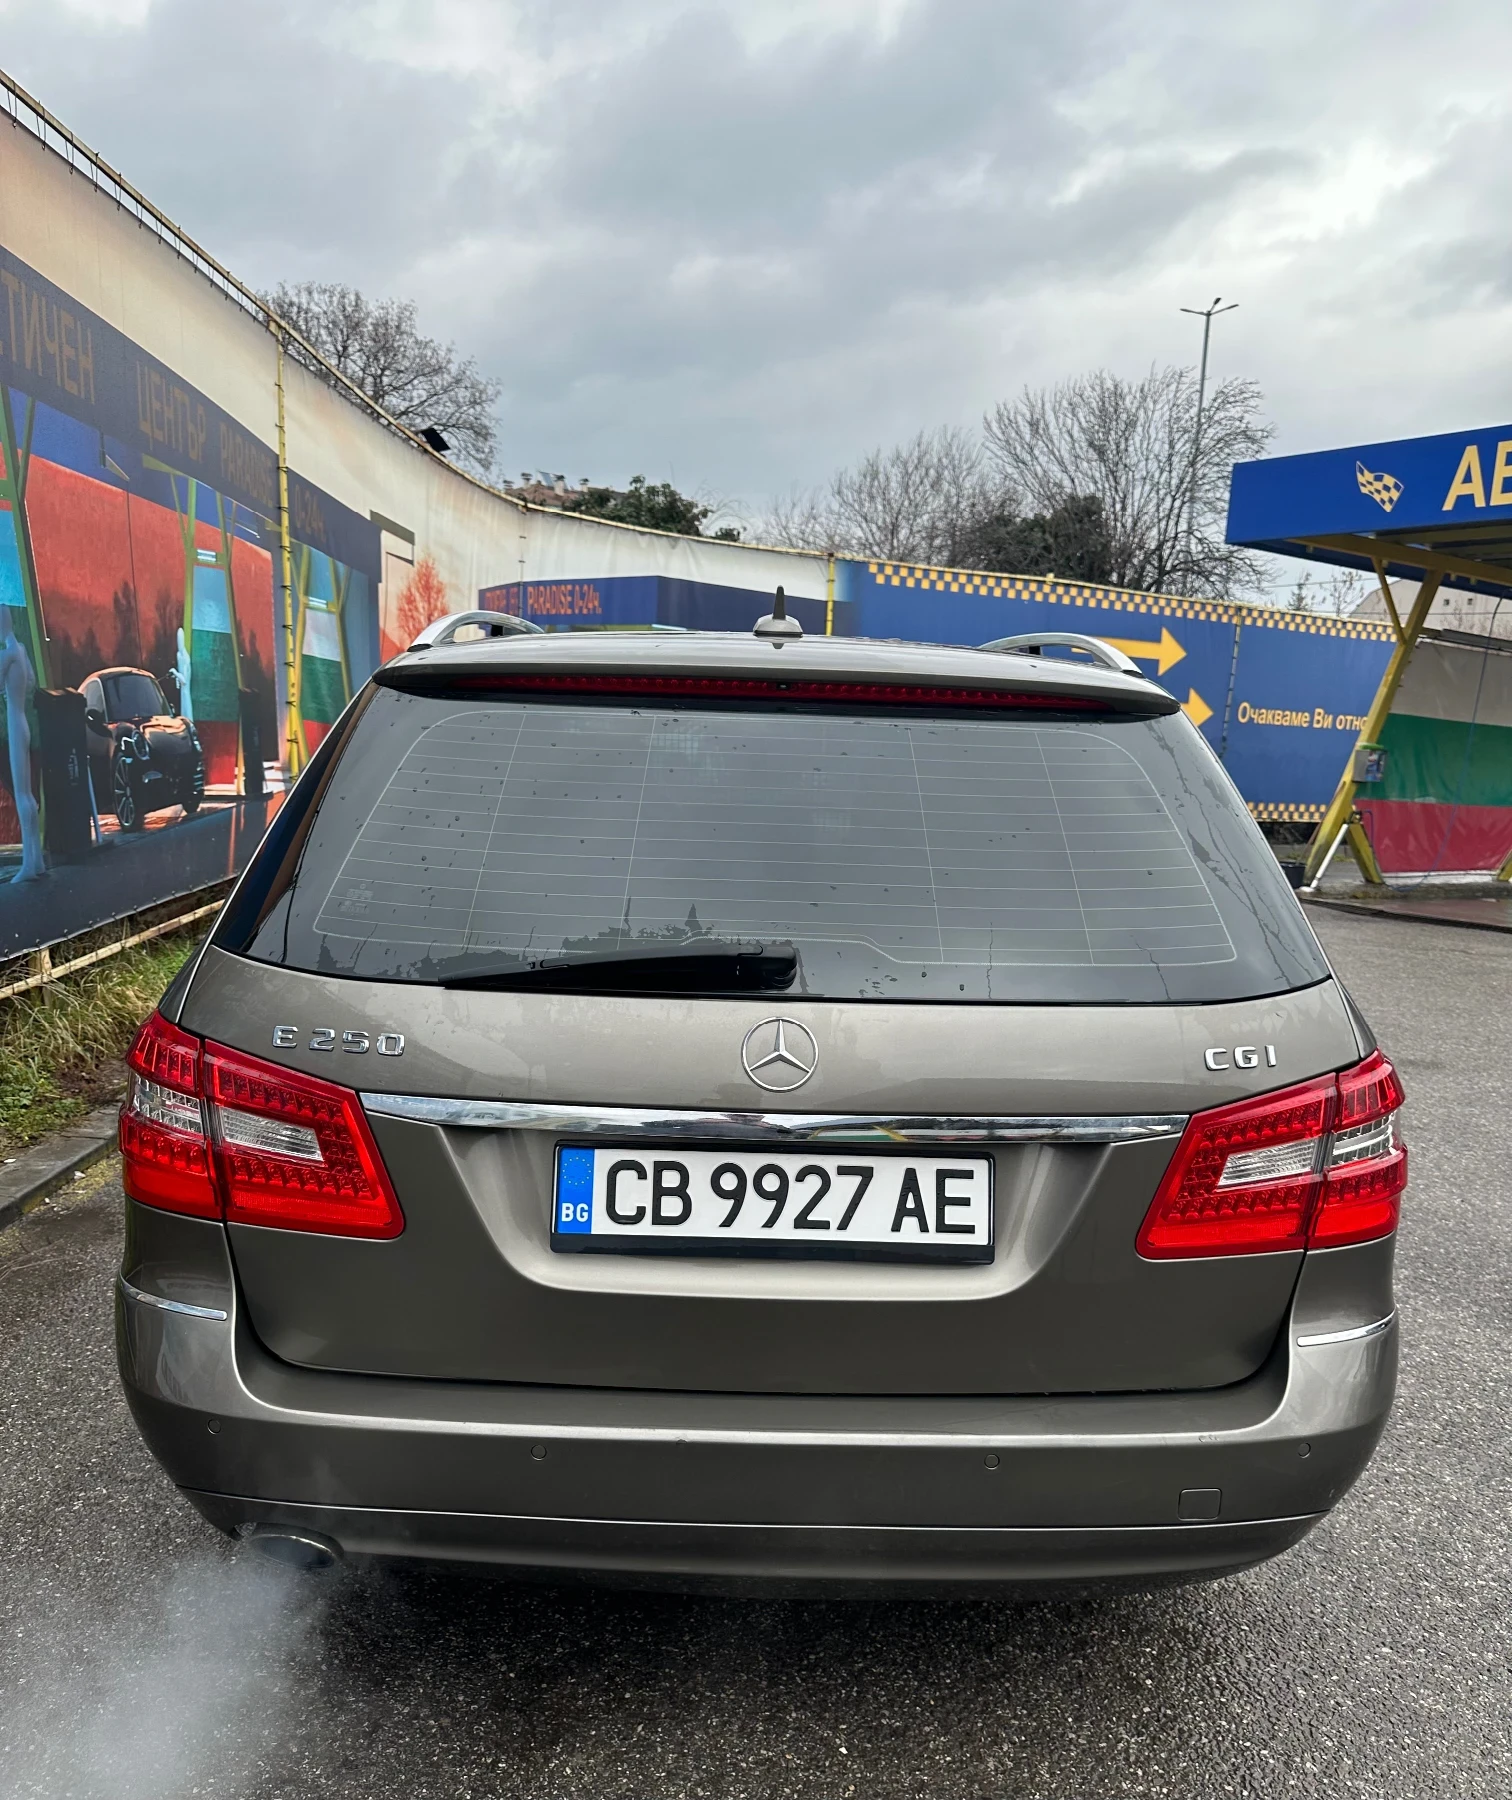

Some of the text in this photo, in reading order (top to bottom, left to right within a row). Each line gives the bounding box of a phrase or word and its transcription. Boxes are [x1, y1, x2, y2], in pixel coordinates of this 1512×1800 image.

[0, 268, 95, 405] ТИЧЕН
[527, 584, 572, 615] PARADISE
[1237, 701, 1310, 728] Очакваме
[1313, 708, 1333, 729] Ви
[272, 1025, 405, 1056] E 250
[1204, 1045, 1277, 1071] CGI
[605, 1159, 976, 1234] CB 9927 AE
[561, 1203, 589, 1222] BG
